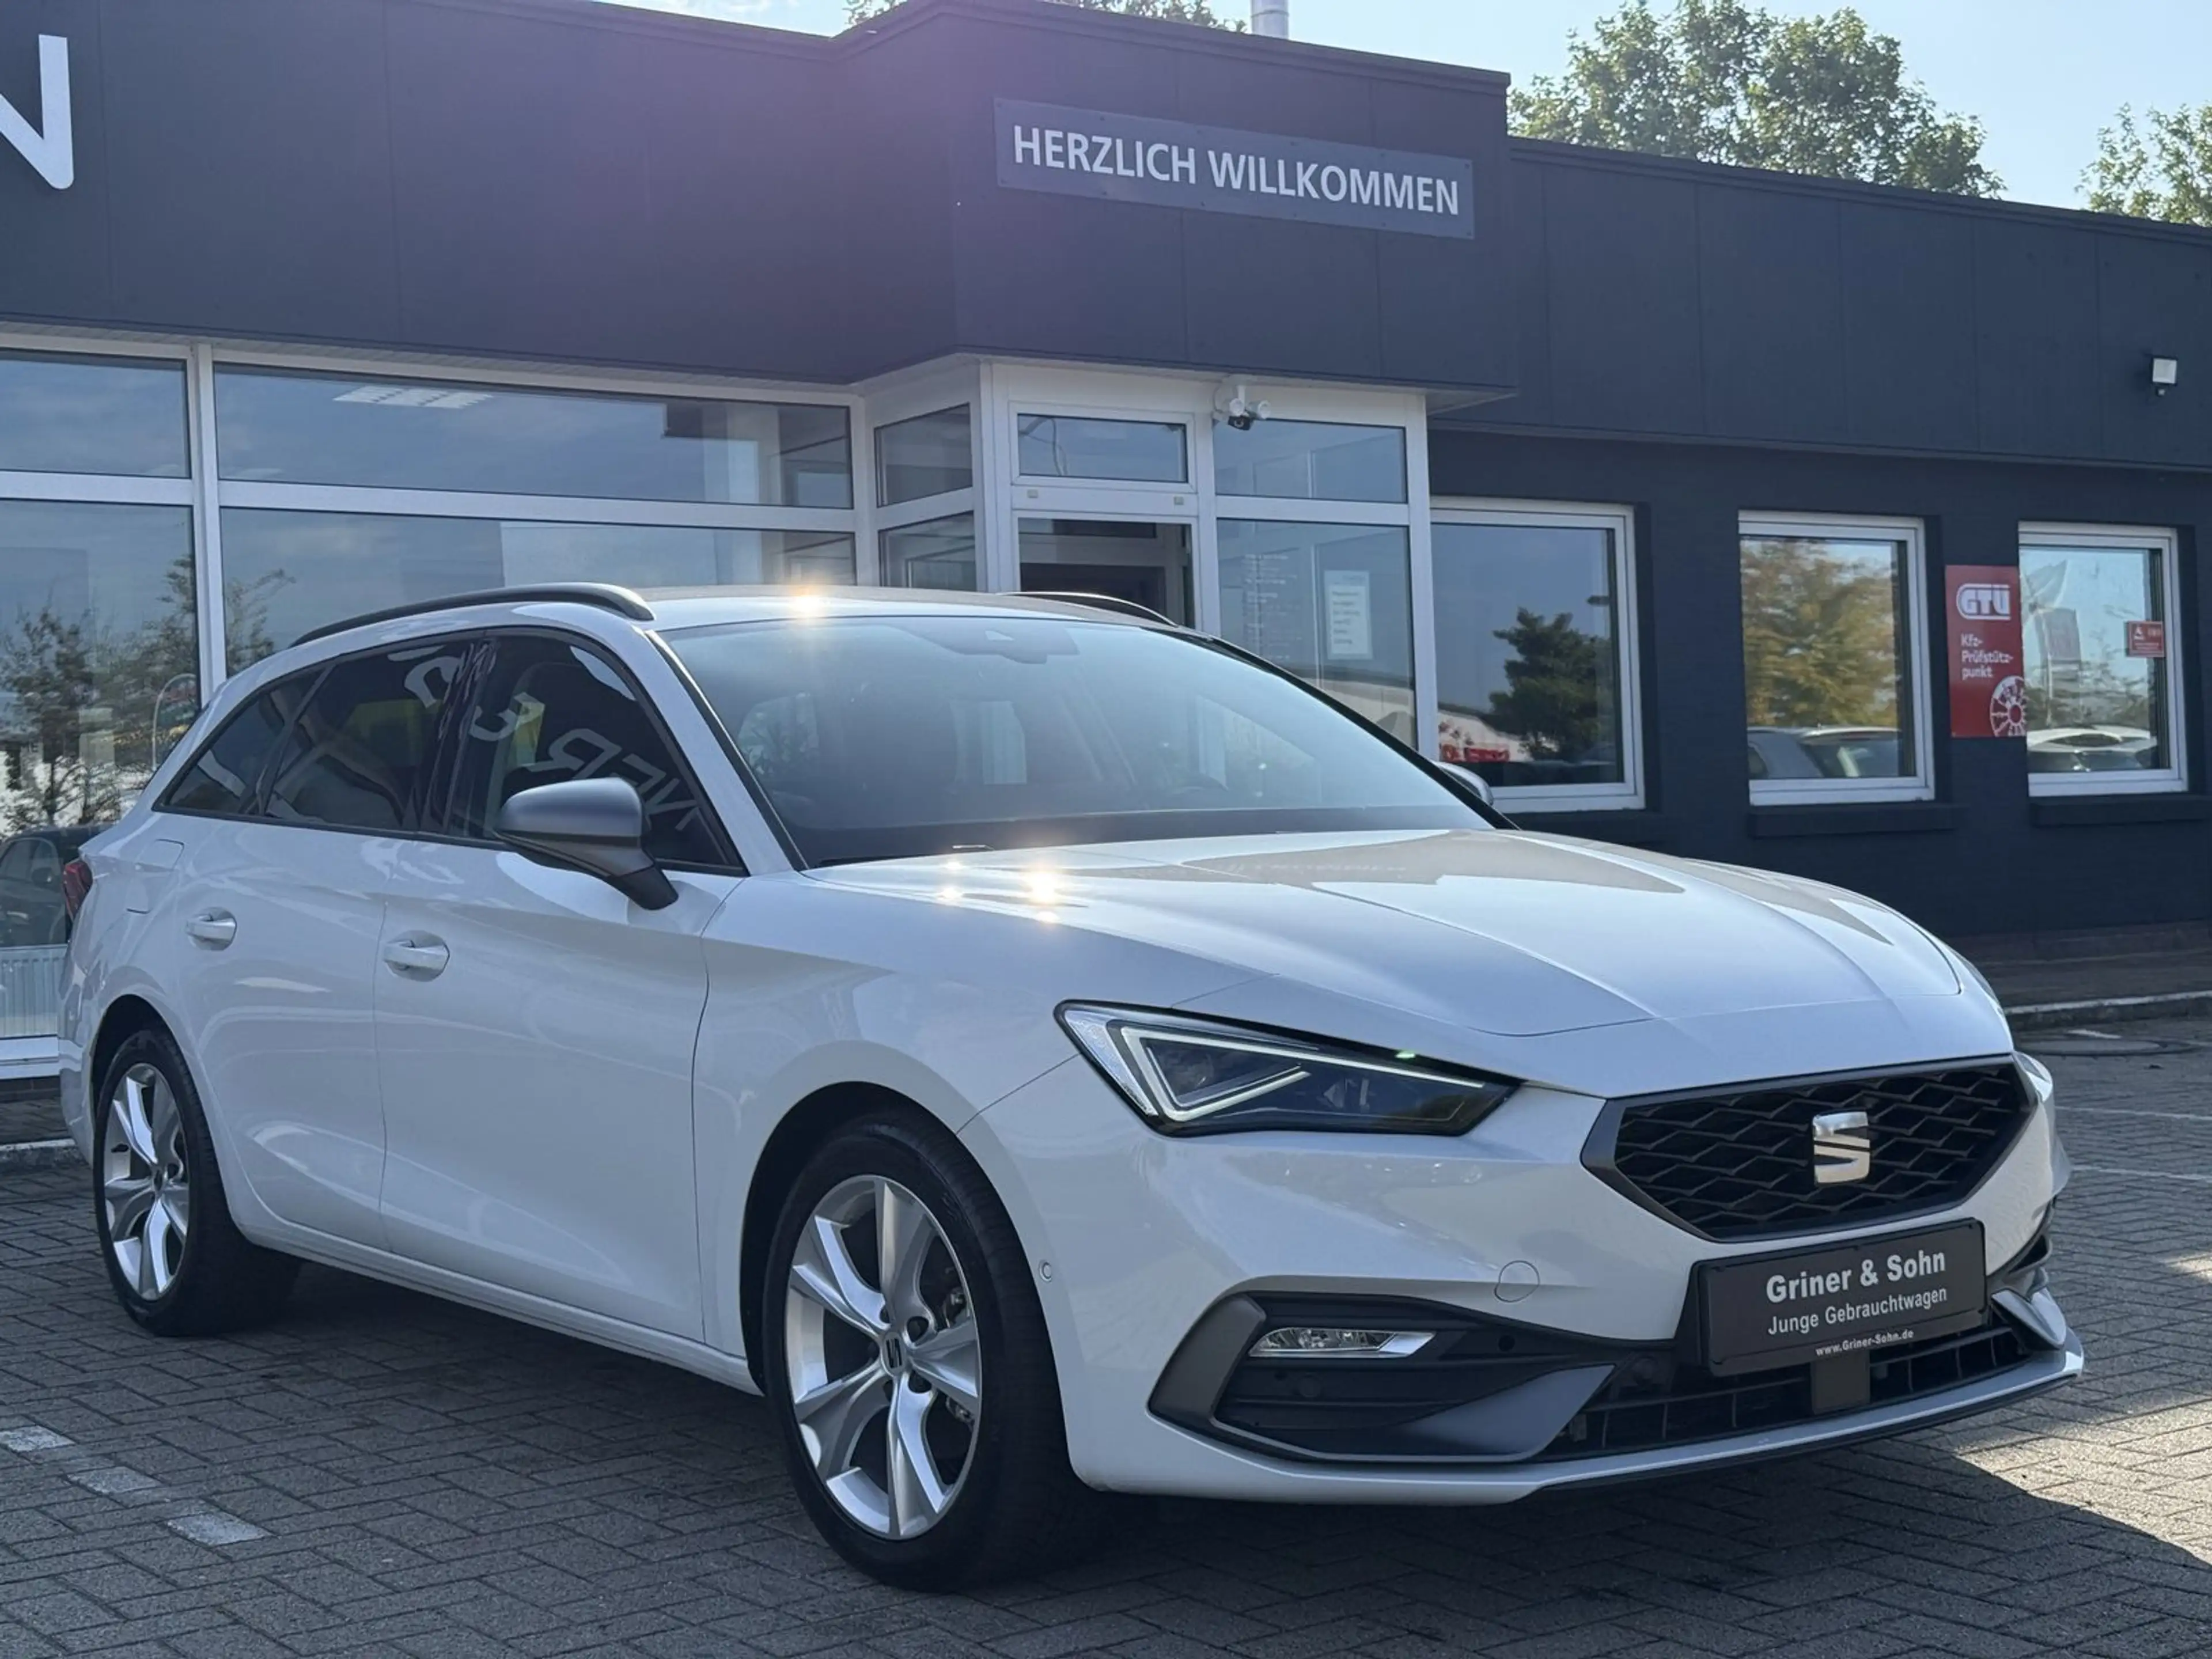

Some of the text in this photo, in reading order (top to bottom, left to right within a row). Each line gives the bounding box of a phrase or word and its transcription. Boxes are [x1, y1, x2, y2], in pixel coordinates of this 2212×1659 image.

[1013, 124, 1459, 215] HERZLICH WILLKOMMEN
[1961, 664, 1994, 680] punkt
[1766, 1249, 1946, 1303] Griner & Sohn
[1767, 1287, 1948, 1335] Junge Gebrauchtwagen
[1815, 1328, 1915, 1358] www.Griner-Sohn.de
